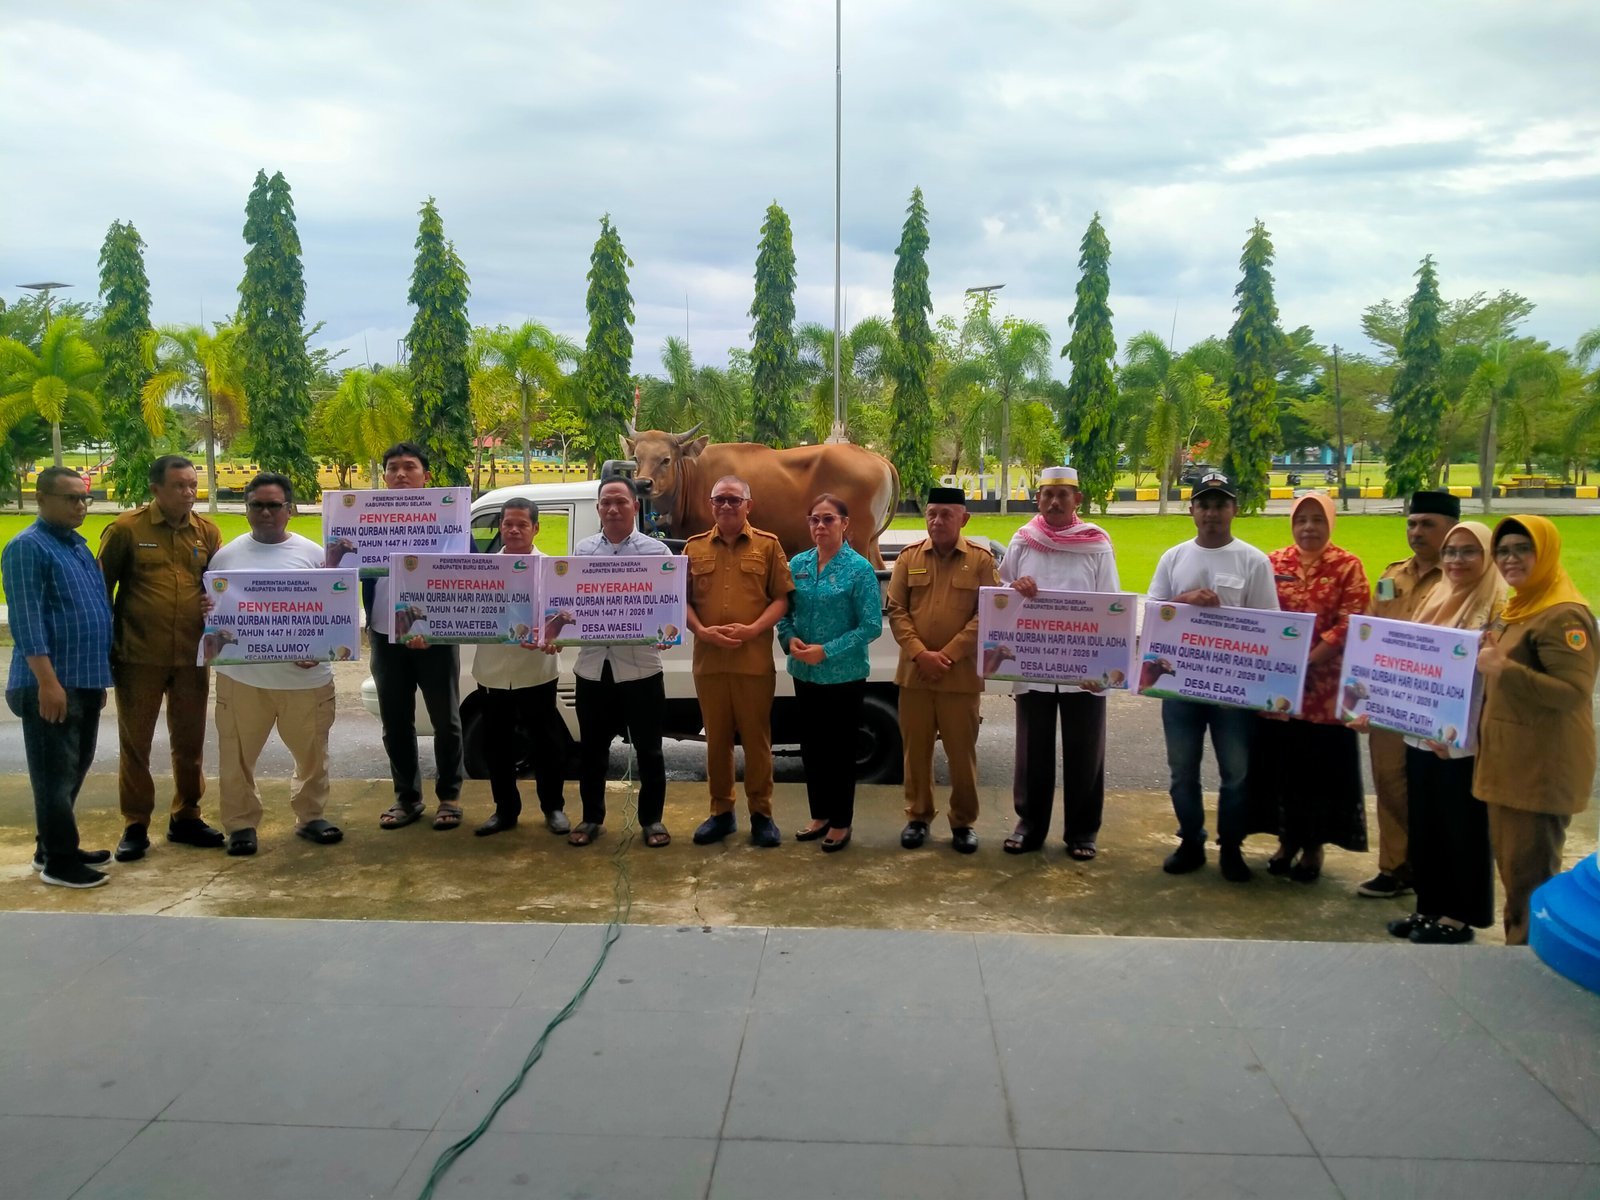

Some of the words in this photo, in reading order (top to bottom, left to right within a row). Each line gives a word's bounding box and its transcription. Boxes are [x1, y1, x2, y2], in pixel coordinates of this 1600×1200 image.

[360, 513, 437, 523] PENYERAHAN
[331, 526, 356, 536] HEWAN
[358, 526, 388, 536] QURBAN
[390, 526, 406, 535] HARI
[408, 526, 425, 535] RAYA
[427, 525, 442, 534] IDUL
[444, 525, 462, 534] ADHA
[427, 580, 504, 590] PENYERAHAN
[576, 582, 652, 593] PENYERAHAN
[400, 592, 424, 602] HEWAN
[426, 592, 456, 602] QURBAN
[458, 592, 474, 602] HARI
[476, 593, 493, 602] RAYA
[495, 593, 510, 602] IDUL
[512, 593, 530, 603] ADHA
[550, 597, 574, 606] HEWAN
[576, 596, 604, 606] QURBAN
[606, 596, 622, 605] HARI
[624, 595, 641, 605] RAYA
[643, 595, 658, 604] IDUL
[660, 594, 678, 604] ADHA
[238, 602, 323, 612] PENYERAHAN
[630, 608, 646, 616] 2026
[208, 615, 235, 625] HEWAN
[238, 615, 270, 625] QURBAN
[272, 615, 290, 625] HARI
[292, 615, 311, 624] RAYA
[313, 615, 328, 624] IDUL
[331, 615, 351, 624] ADHA
[430, 621, 453, 629] DESA
[455, 621, 498, 629] WAETEBA
[1017, 618, 1099, 633] PENYERAHAN
[238, 629, 264, 637] TAHUN
[582, 624, 605, 632] DESA
[608, 623, 642, 632] WAESILI
[988, 631, 1014, 641] HEWAN
[1016, 632, 1046, 643] QURBAN
[1048, 634, 1065, 644] HARI
[1067, 635, 1086, 645] RAYA
[1088, 637, 1104, 646] IDUL
[1106, 637, 1126, 647] ADHA
[1181, 633, 1269, 656] PENYERAHAN
[248, 644, 273, 652] DESA
[276, 644, 310, 652] LUMOY
[1015, 646, 1040, 654] TAHUN
[1073, 649, 1090, 657] 2026
[1150, 642, 1177, 655] HEWAN
[1179, 648, 1211, 661] QURBAN
[1213, 653, 1231, 664] HARI
[1233, 655, 1253, 666] RAYA
[1255, 660, 1272, 671] IDUL
[1275, 663, 1296, 674] ADHA
[1021, 661, 1043, 670] DESA
[1045, 663, 1087, 673] LABUANG
[1176, 661, 1203, 672] TAHUN
[1206, 666, 1222, 675] 1447
[1225, 669, 1231, 677] H
[1258, 674, 1265, 682] M
[1185, 678, 1211, 690] DESA
[1213, 683, 1246, 696] ELARA
